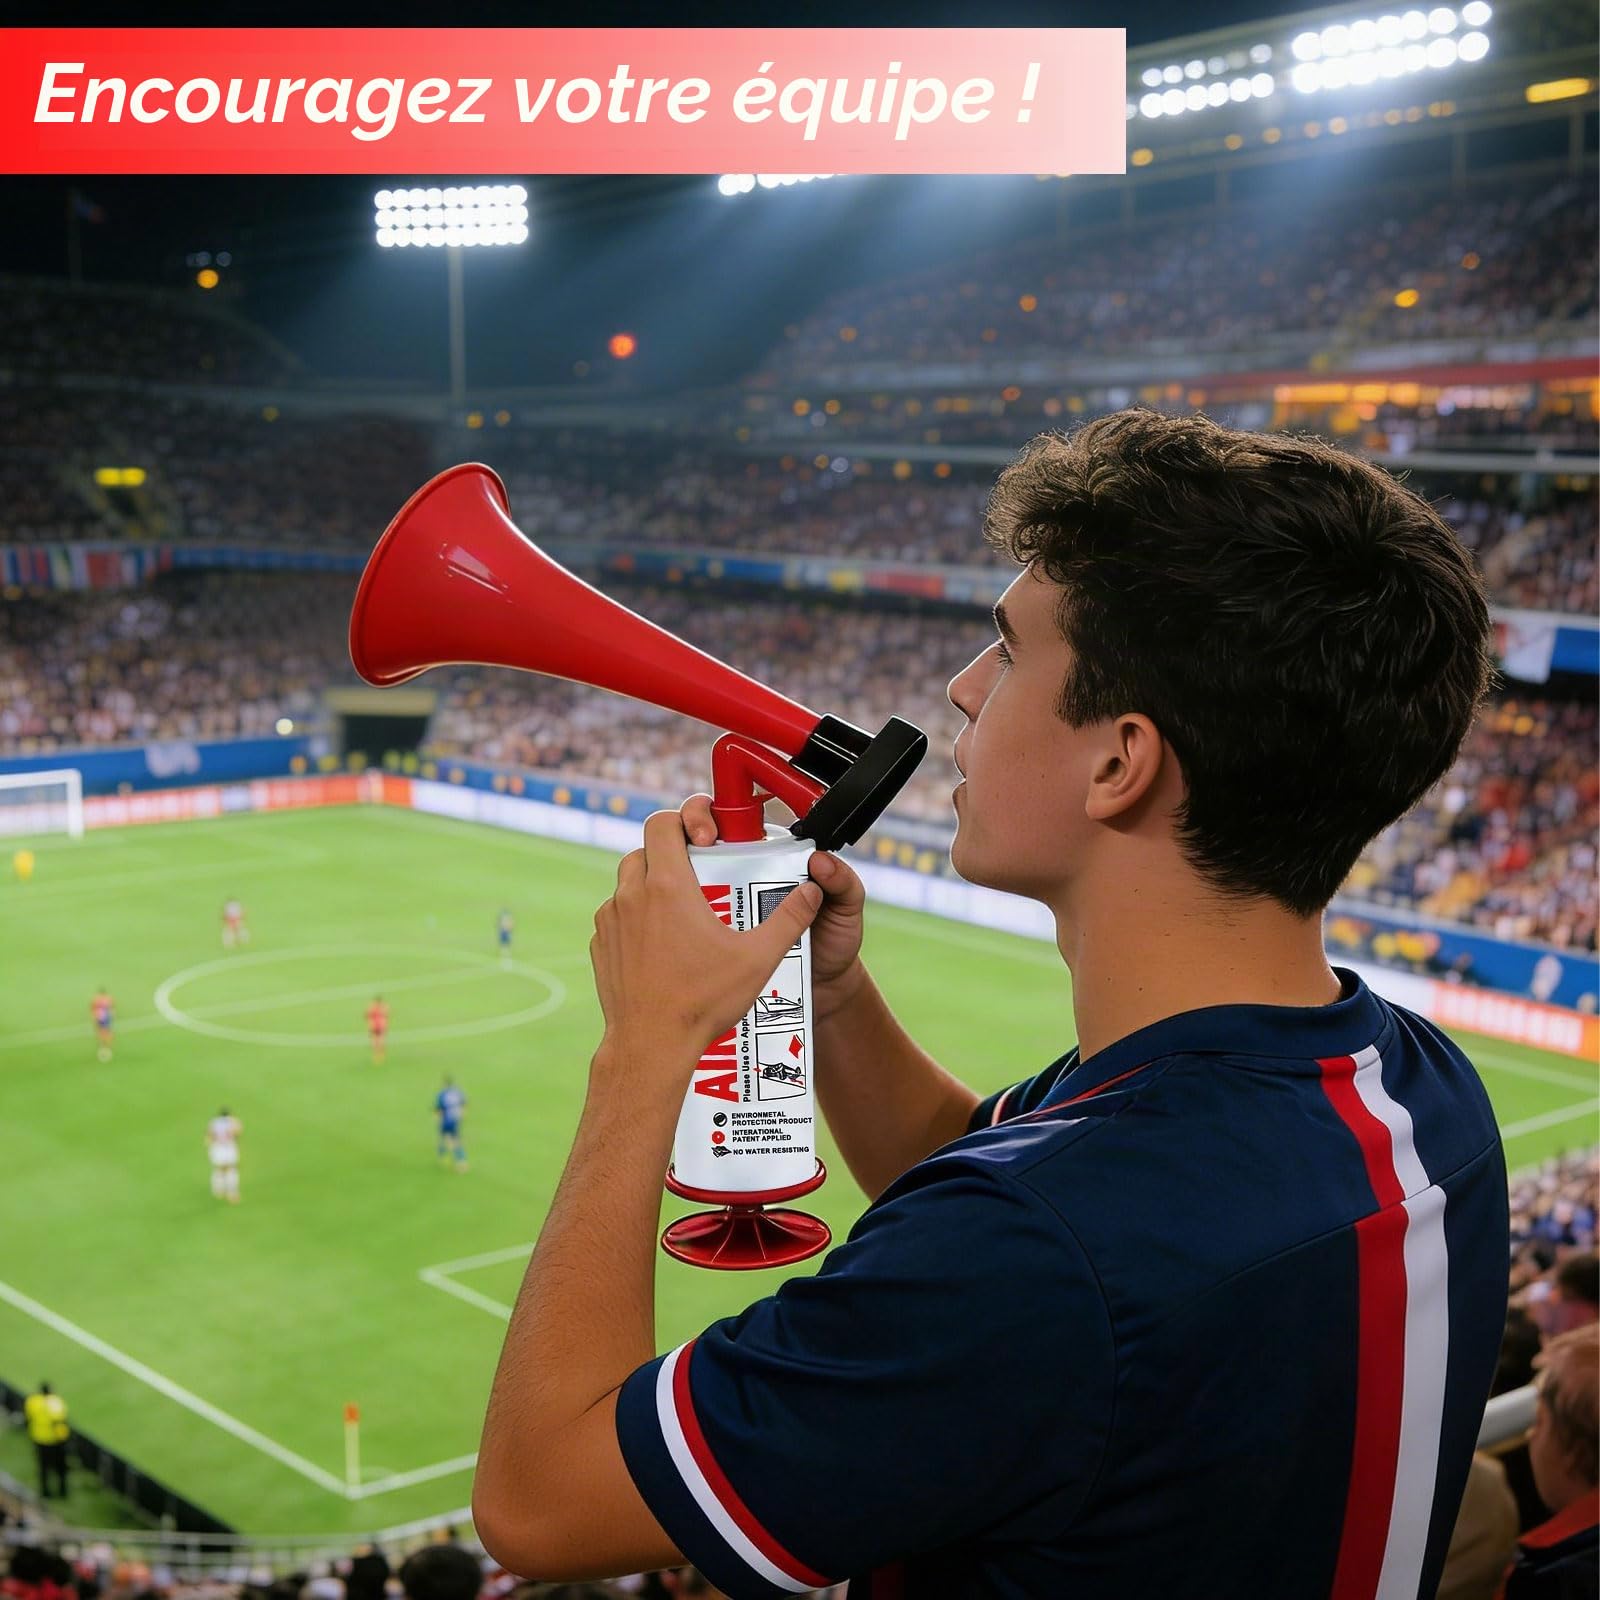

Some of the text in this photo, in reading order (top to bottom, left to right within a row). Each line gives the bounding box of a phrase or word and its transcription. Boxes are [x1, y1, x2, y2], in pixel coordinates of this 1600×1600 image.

[741, 1040, 749, 1053] On
[742, 1055, 750, 1072] Use
[742, 1073, 751, 1103] Please
[731, 1111, 787, 1119] ENVIRONMETAL
[732, 1117, 813, 1126] PROTECTION PRODUCT
[732, 1128, 783, 1136] INTERATIONAL
[761, 1134, 792, 1142] APPLIED
[745, 1147, 771, 1155] WATER
[772, 1146, 810, 1154] RESISTING
